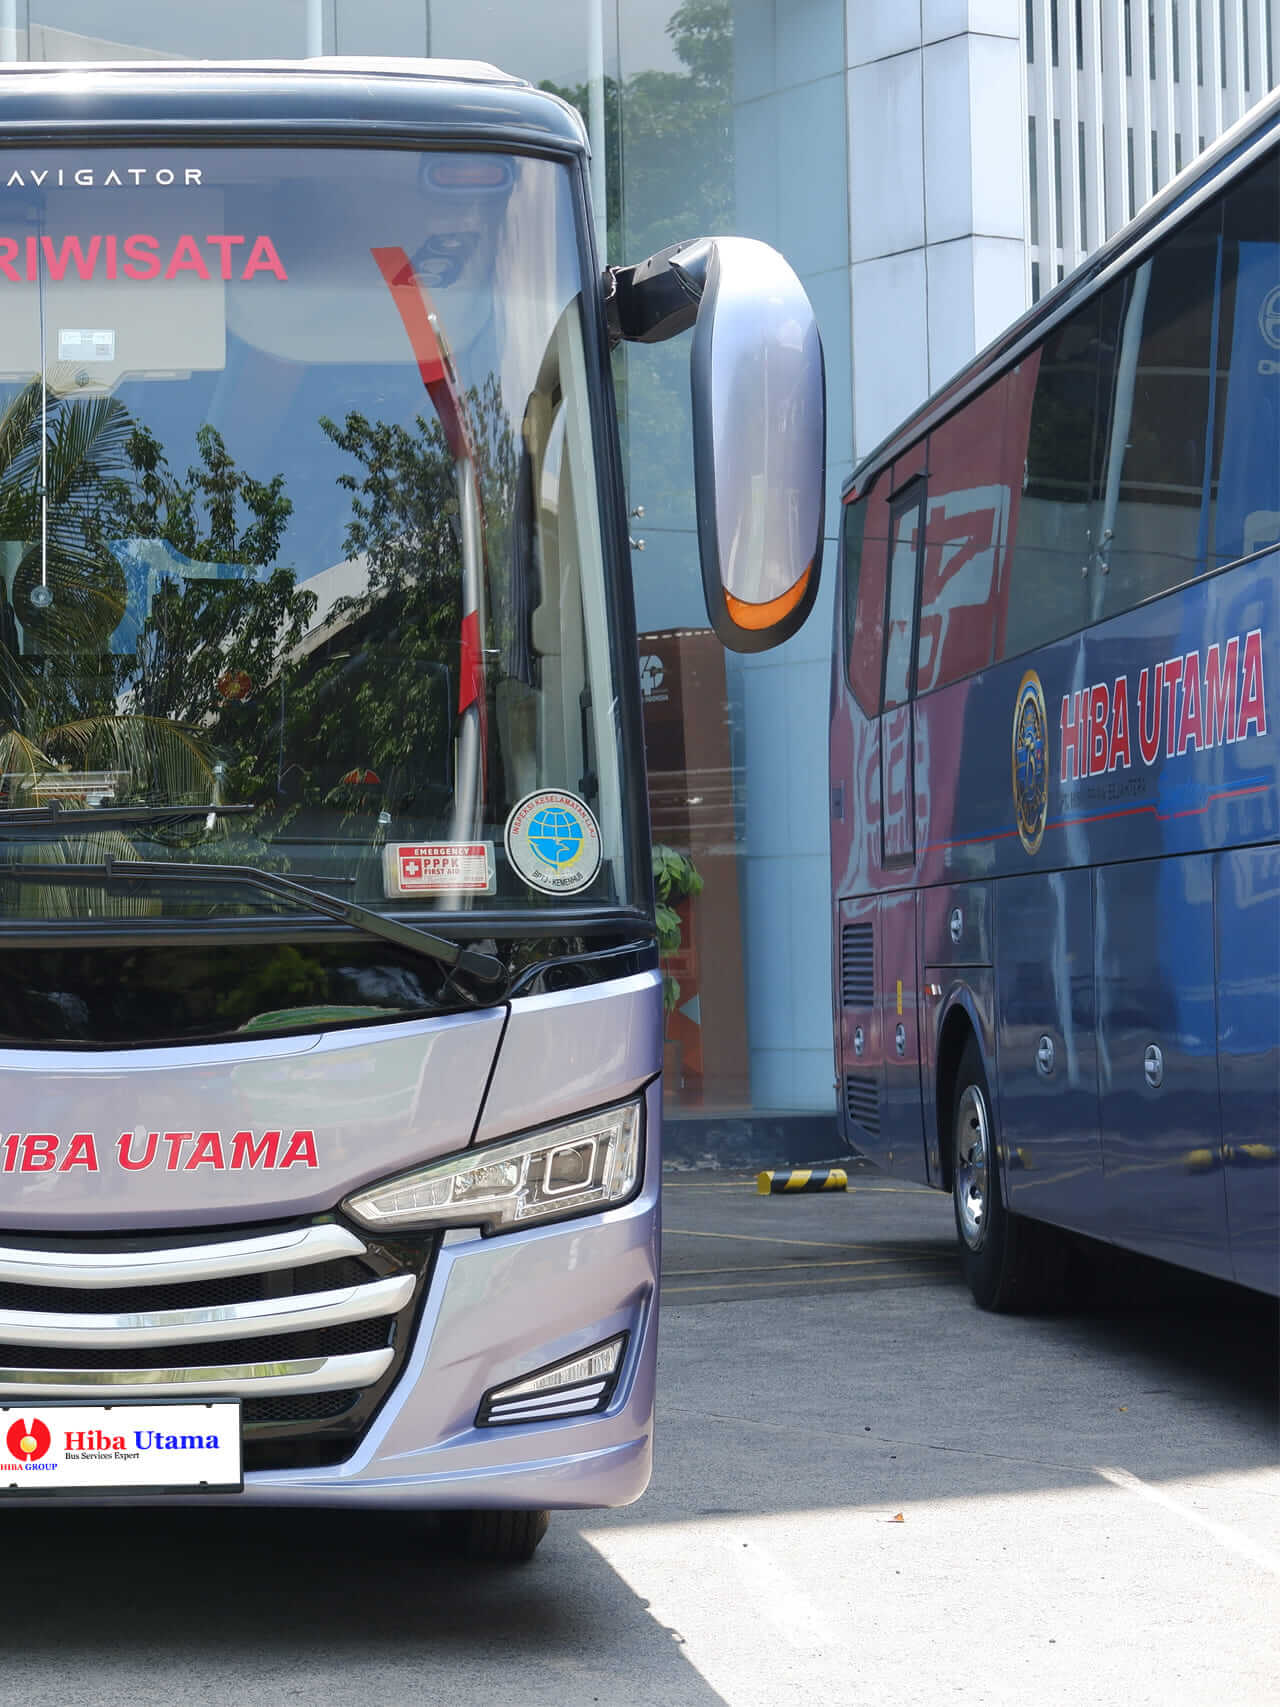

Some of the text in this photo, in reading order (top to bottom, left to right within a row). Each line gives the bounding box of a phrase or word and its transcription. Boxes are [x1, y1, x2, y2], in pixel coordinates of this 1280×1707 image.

[1059, 628, 1268, 784] HIBA UTAMA
[414, 847, 470, 857] EMERGENCY
[423, 858, 459, 868] PPPK
[115, 1129, 320, 1172] UTAMA
[63, 1430, 220, 1451] Hiba Utama
[65, 1452, 140, 1461] Bus Services Expert
[0, 1463, 58, 1471] HIBA GROUP
